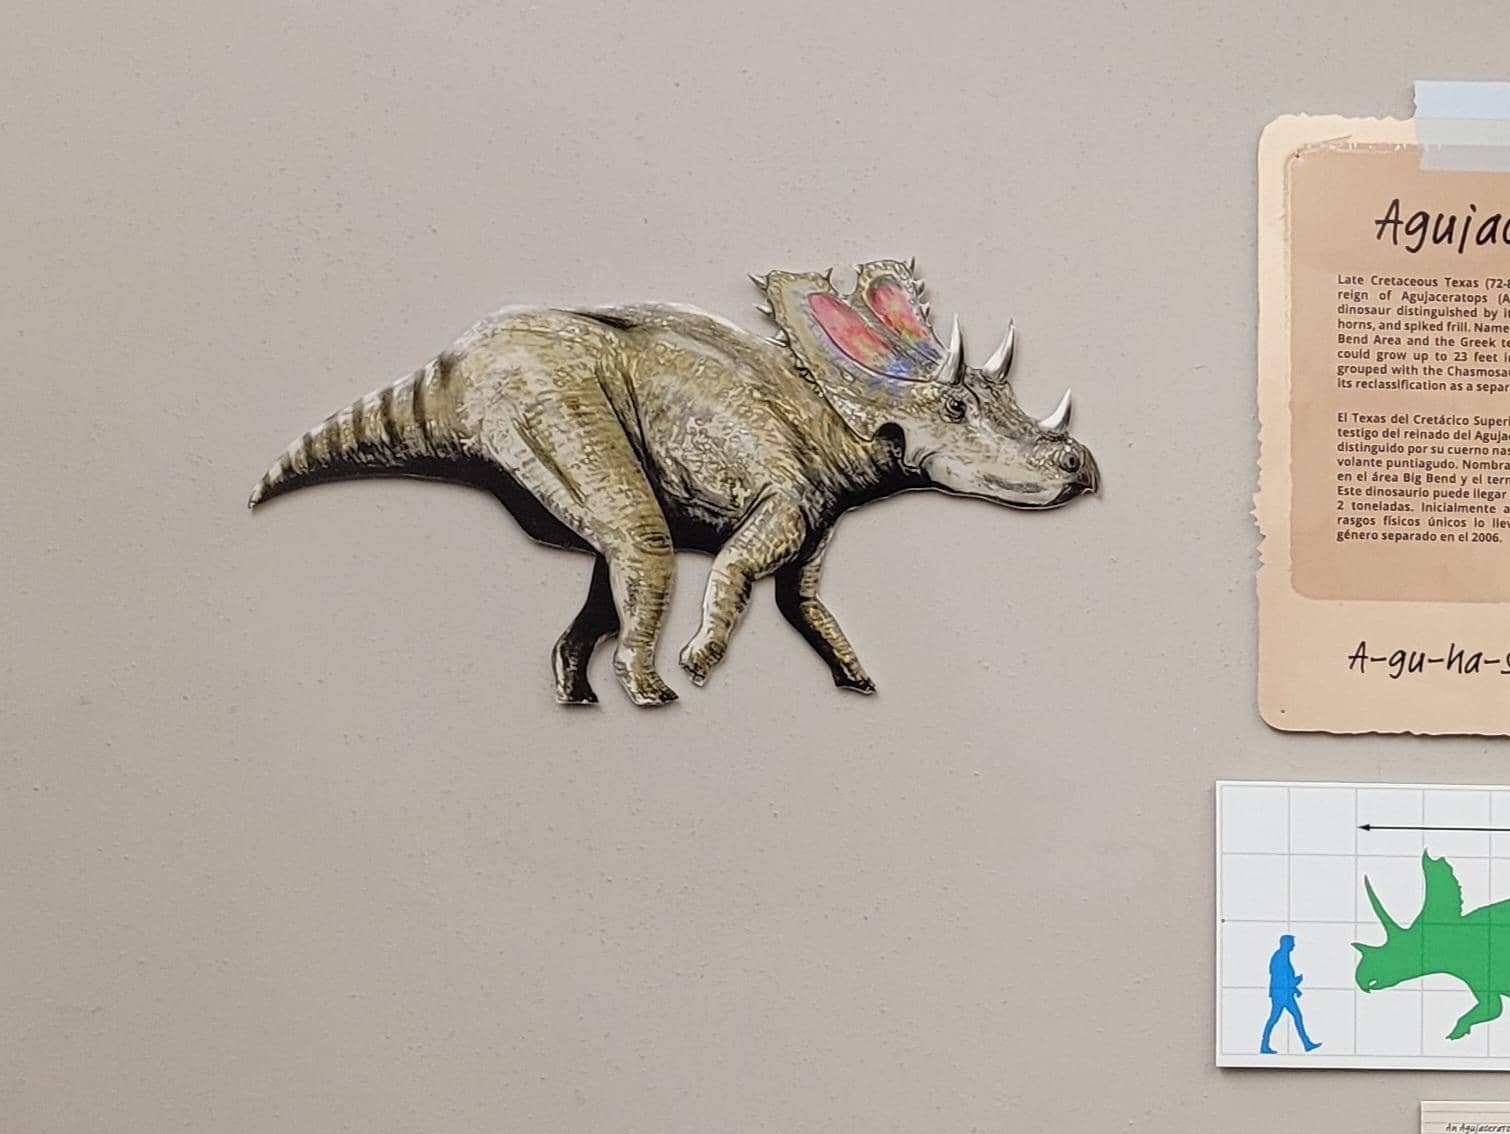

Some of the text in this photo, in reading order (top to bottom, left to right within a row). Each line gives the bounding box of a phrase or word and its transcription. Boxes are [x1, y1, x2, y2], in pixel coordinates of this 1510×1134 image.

[1338, 274, 1364, 285] Late
[1370, 275, 1438, 287] Cretaceous
[1443, 277, 1479, 288] Texas
[1337, 289, 1368, 302] reign
[1379, 290, 1392, 301] of
[1401, 291, 1488, 306] Agujaceratops
[1337, 303, 1392, 315] dinosaur
[1396, 305, 1478, 320] distinguished
[1483, 307, 1498, 321] by
[1337, 318, 1376, 331] horns,
[1378, 319, 1401, 330] and
[1403, 320, 1443, 334] spiked
[1446, 321, 1471, 333] frill.
[1337, 333, 1368, 344] Bend
[1373, 334, 1401, 345] Area
[1406, 335, 1429, 346] and
[1435, 335, 1455, 347] the
[1460, 336, 1496, 348] Greek
[1337, 412, 1347, 423] El
[1351, 412, 1386, 424] Texas
[1390, 413, 1409, 424] del
[1413, 414, 1469, 425] Cretácico
[1337, 427, 1378, 440] testigo
[1381, 427, 1400, 438] del
[1403, 428, 1450, 440] reinado
[1453, 429, 1471, 440] del
[1336, 500, 1344, 511] 2
[1351, 500, 1414, 512] toneladas.
[1421, 501, 1496, 514] Inicialmente
[1446, 1123, 1457, 1132] An
